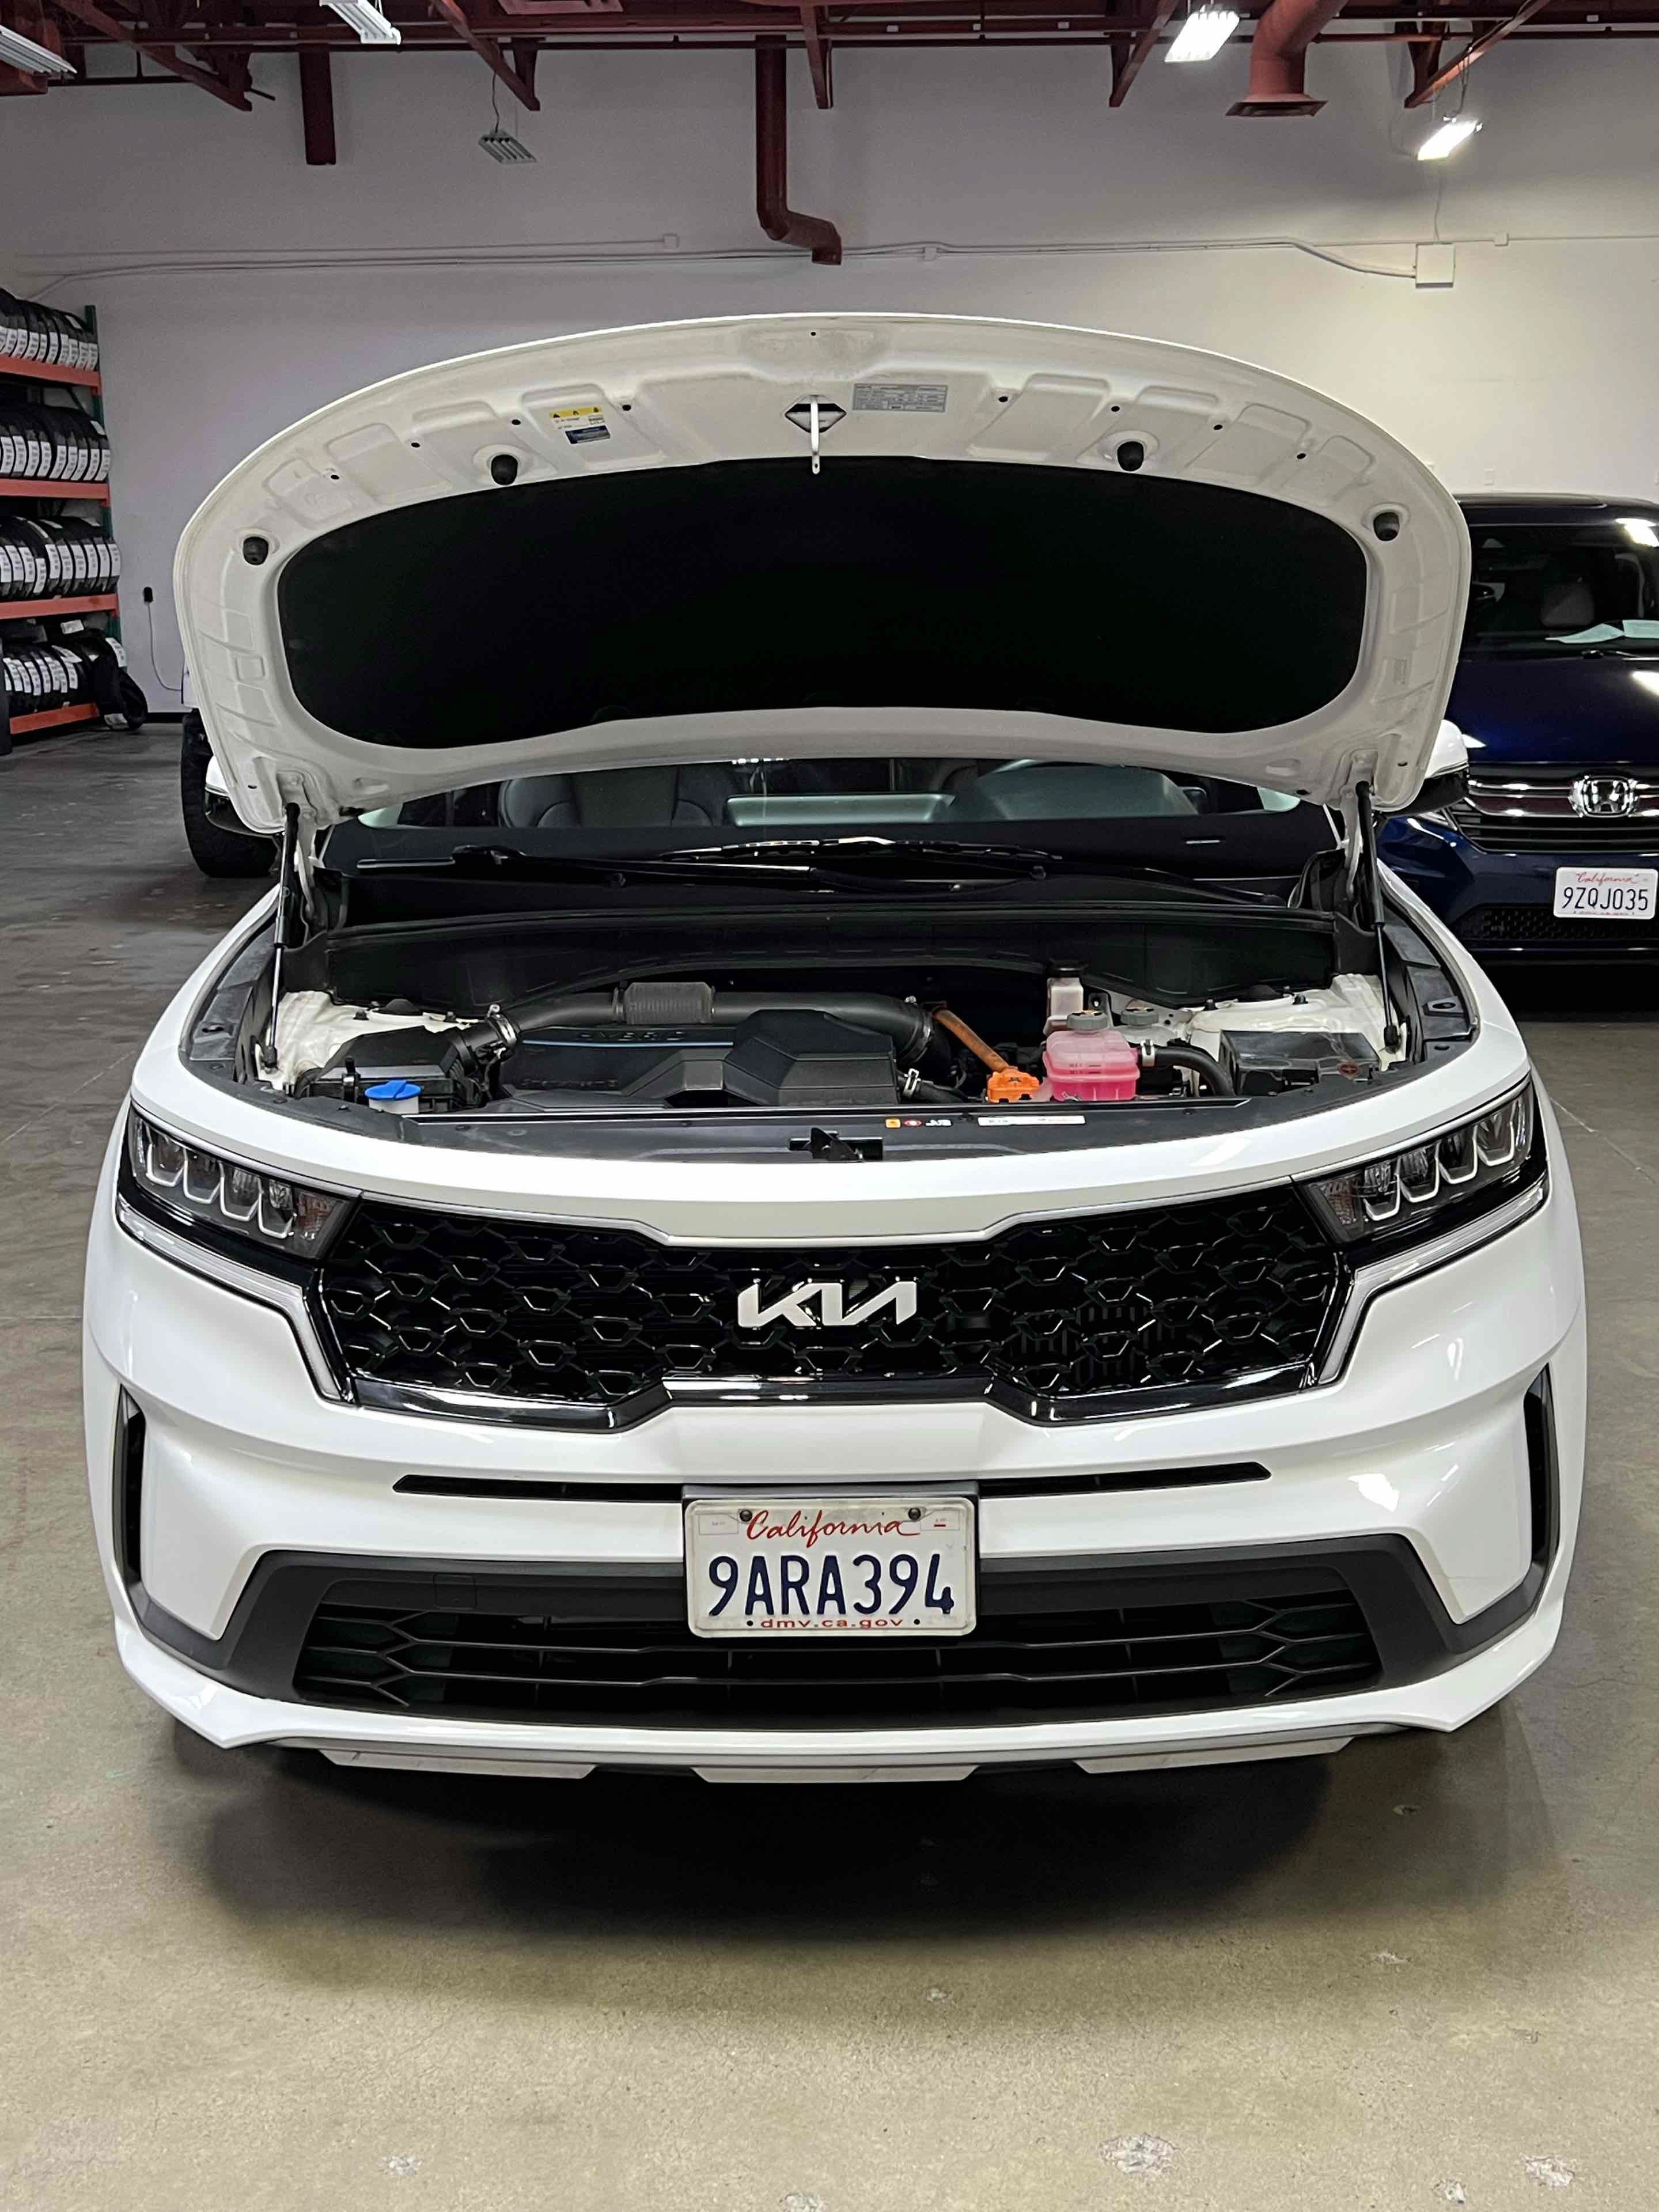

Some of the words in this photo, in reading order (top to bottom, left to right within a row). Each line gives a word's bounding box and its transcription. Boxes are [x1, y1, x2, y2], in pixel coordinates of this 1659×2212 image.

[1578, 872, 1638, 885] California
[1562, 887, 1649, 911] 9ZQJ035
[737, 1281, 917, 1327] KIA
[746, 1510, 921, 1548] California
[709, 1553, 955, 1616] 9ARA394
[760, 1617, 904, 1628] dmv.ca.gov
